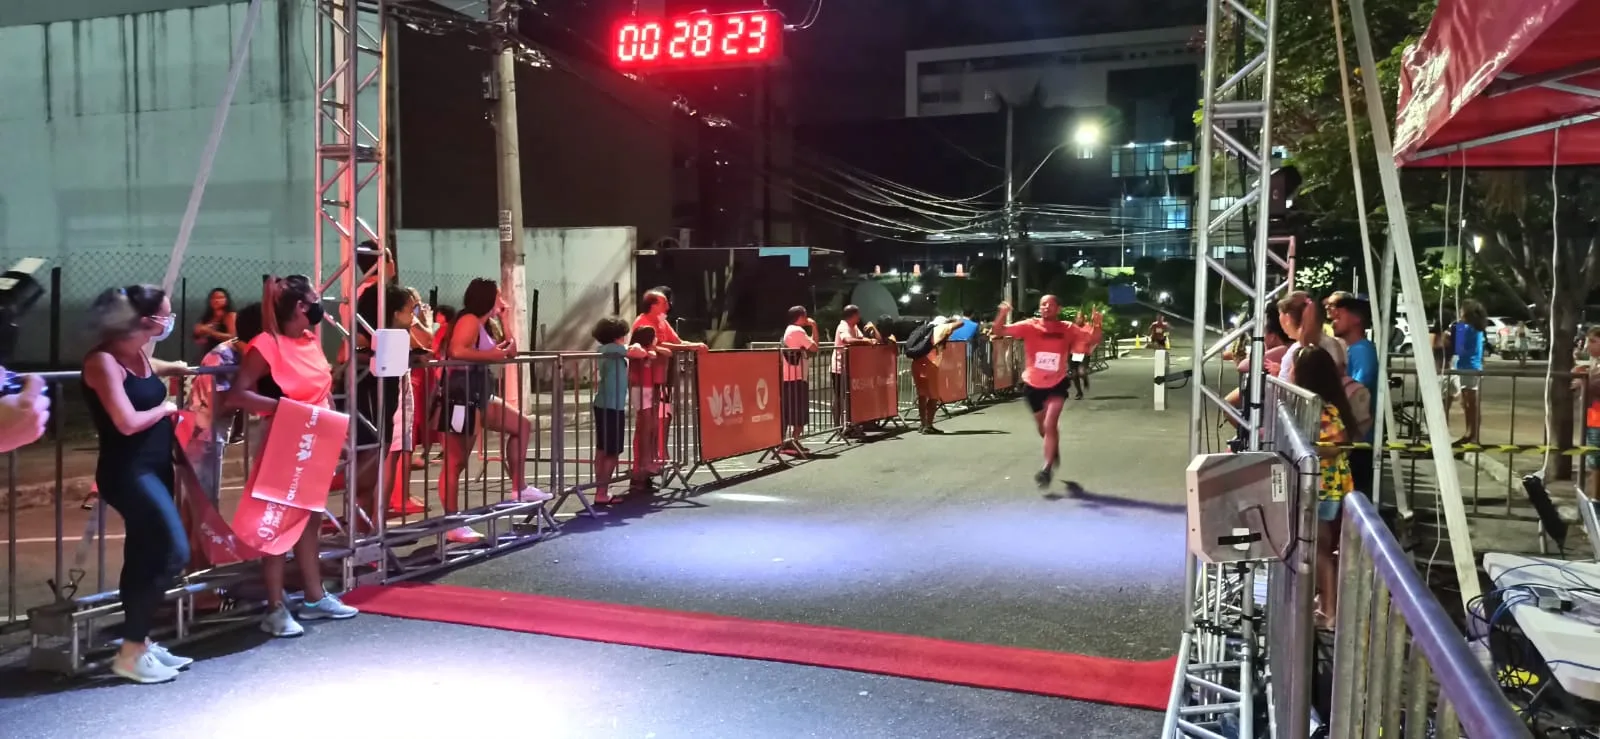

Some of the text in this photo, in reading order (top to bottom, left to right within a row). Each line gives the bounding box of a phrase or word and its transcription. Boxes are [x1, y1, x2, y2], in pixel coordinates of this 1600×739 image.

[617, 15, 768, 62] 00 28 23
